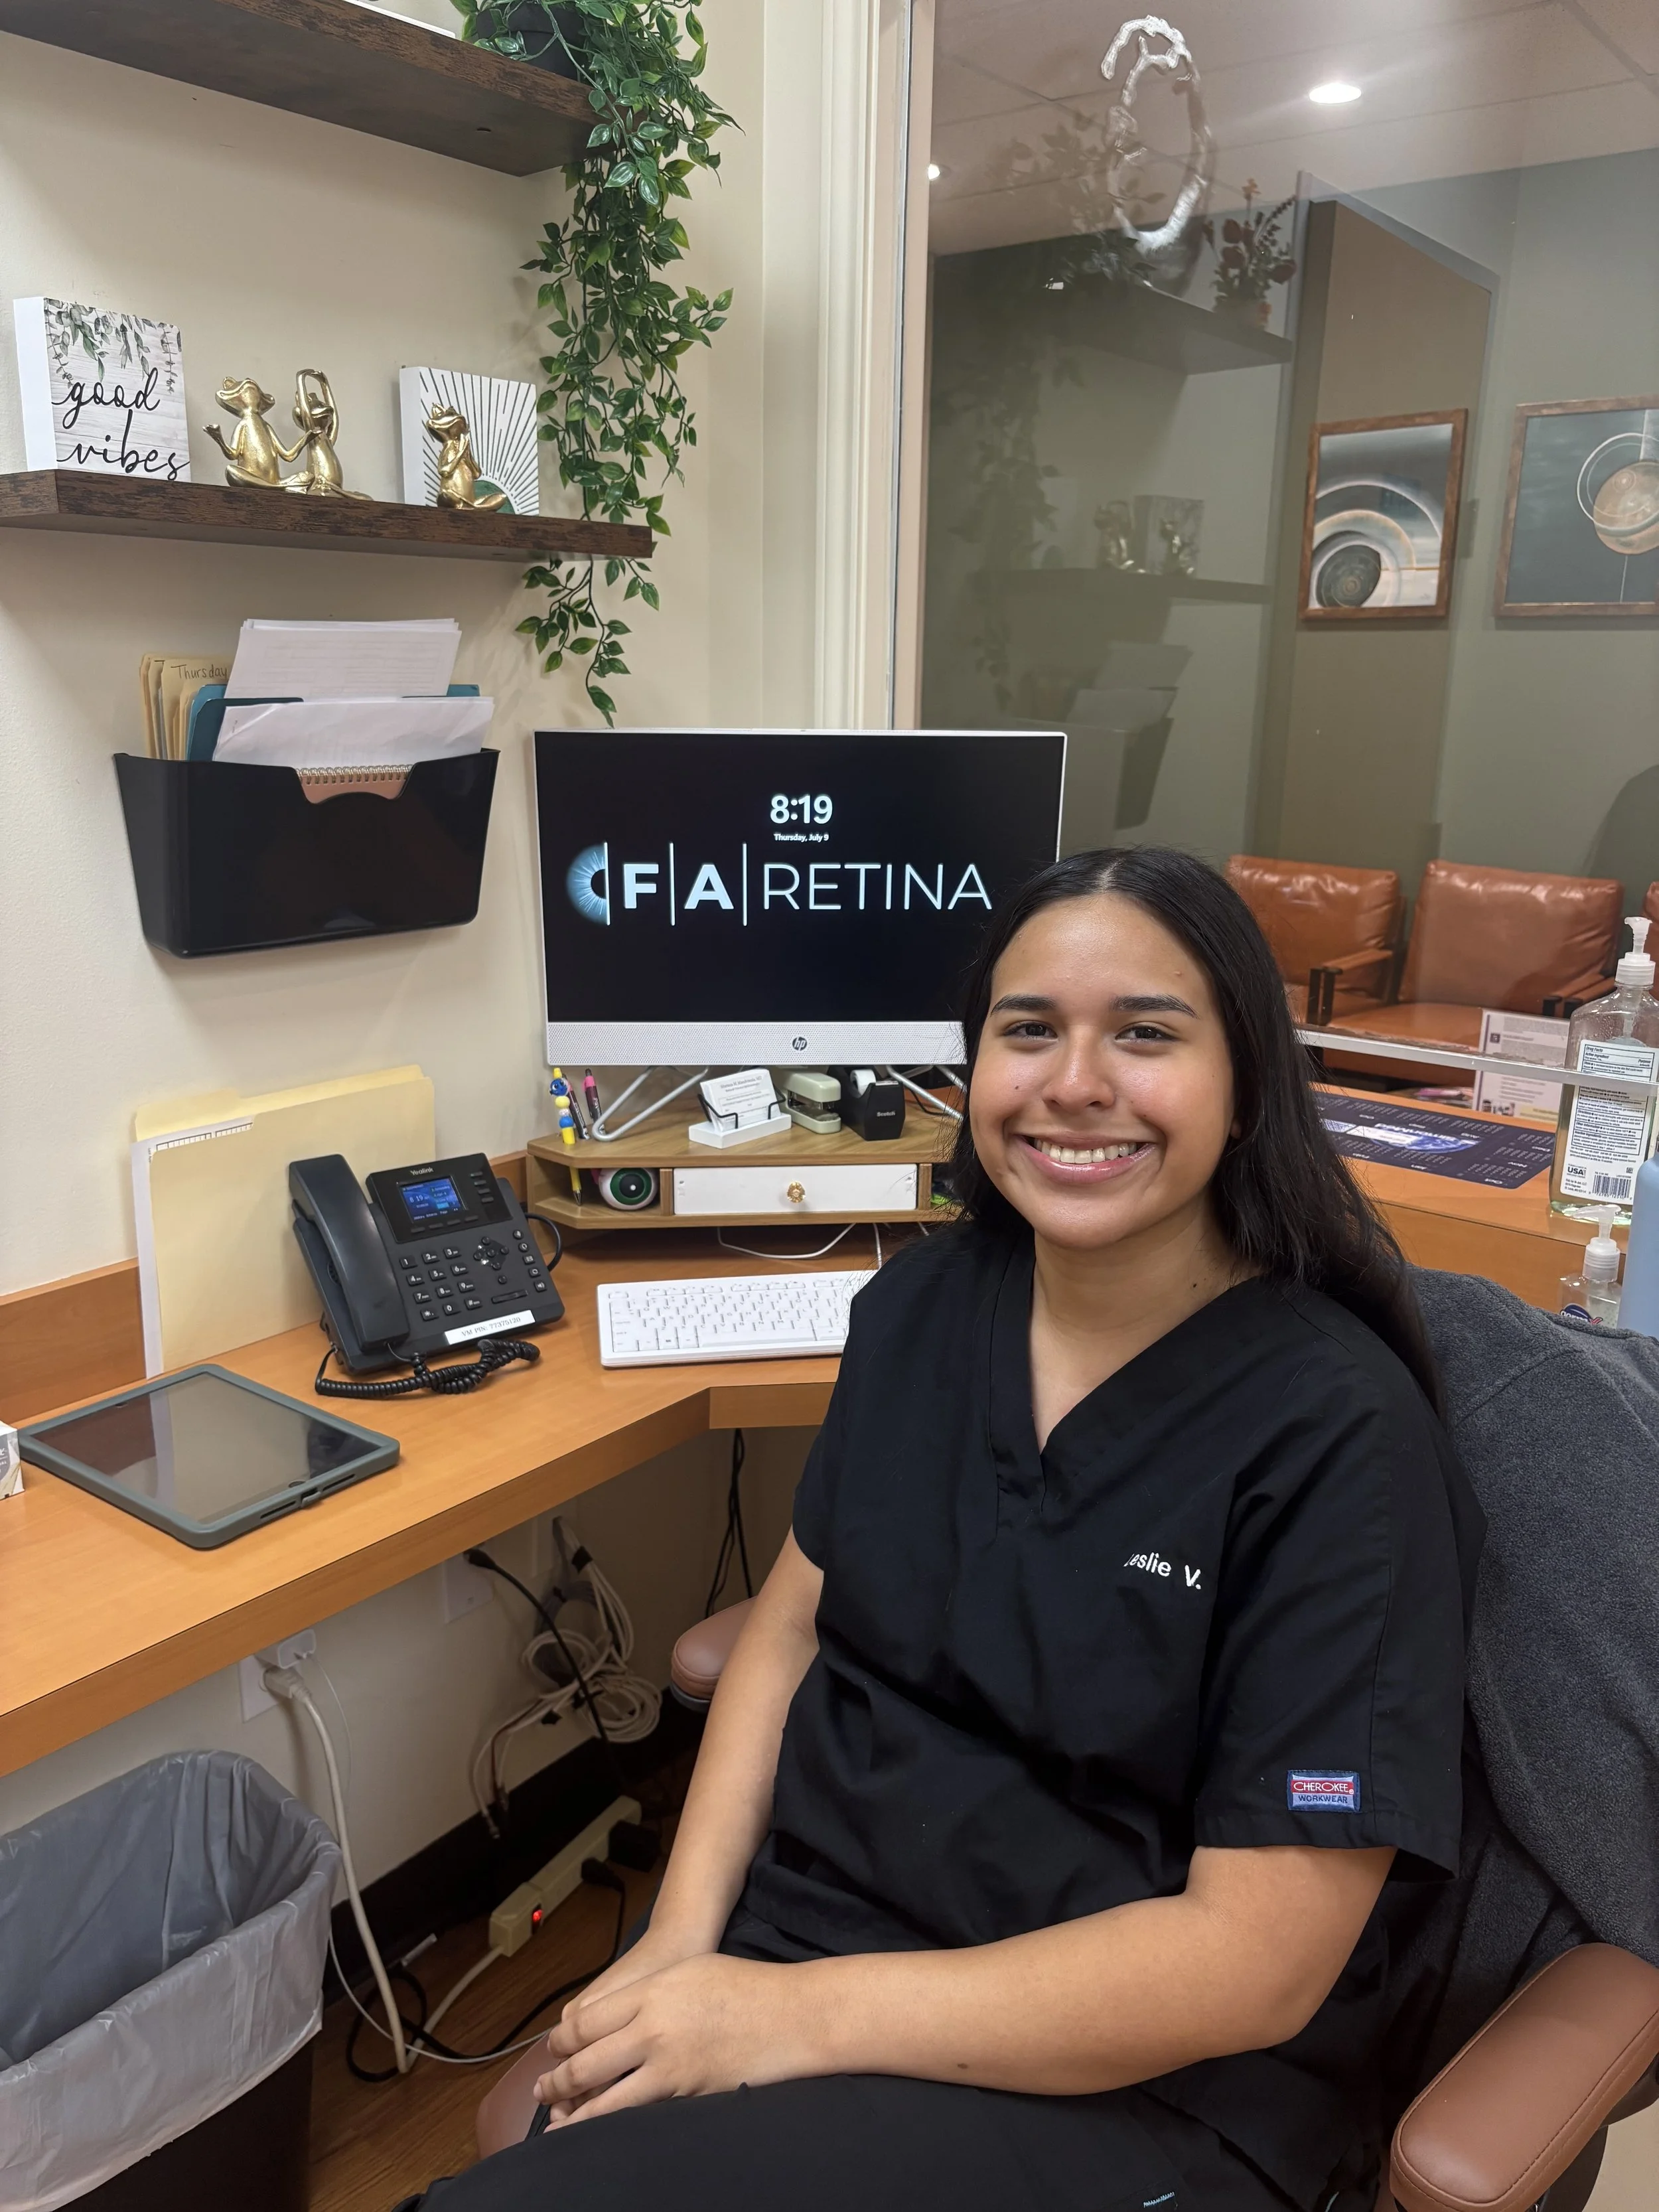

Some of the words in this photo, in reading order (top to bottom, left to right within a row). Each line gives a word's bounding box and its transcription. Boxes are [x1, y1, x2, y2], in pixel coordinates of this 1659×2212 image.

[51, 367, 161, 429] good
[56, 409, 190, 481] vibes
[171, 664, 228, 680] Thursday
[770, 794, 833, 824] 8:19
[773, 833, 808, 842] Thursday,
[809, 833, 823, 842] July
[824, 833, 830, 842] 9
[764, 863, 992, 910] RETINA
[792, 1037, 808, 1051] hp
[410, 1167, 435, 1176] Yealink
[1567, 1166, 1584, 1175] USA
[1184, 1564, 1202, 1590] V.
[1293, 1781, 1349, 1793] CHEROKEE
[1298, 1795, 1348, 1804] WORKWEAR
